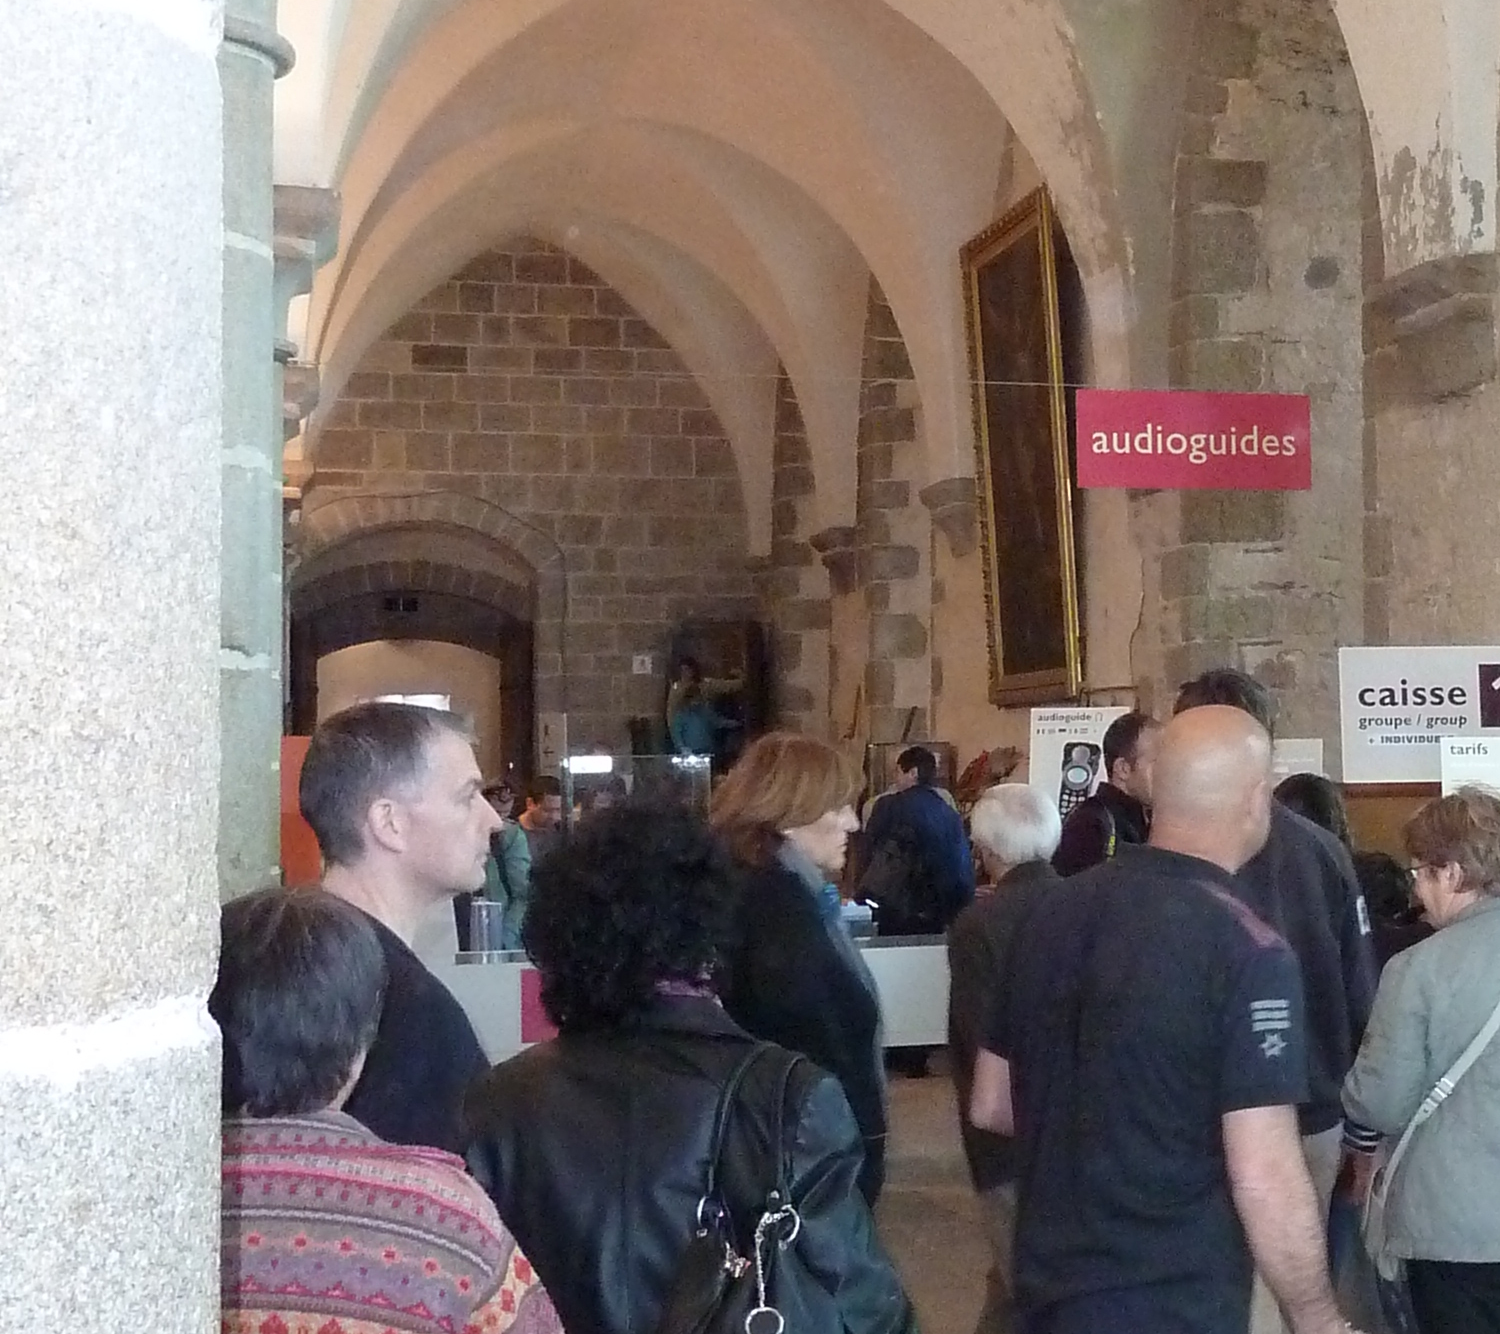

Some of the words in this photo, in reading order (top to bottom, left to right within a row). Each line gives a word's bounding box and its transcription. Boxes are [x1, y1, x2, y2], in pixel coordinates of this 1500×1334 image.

[1091, 422, 1296, 464] audioguides
[1358, 678, 1467, 707] caisse
[1037, 712, 1092, 723] audioguide
[1358, 717, 1412, 730] groupe
[1425, 715, 1468, 729] group
[1380, 734, 1455, 744] INDIVIDUE
[1450, 742, 1488, 755] tarifs
